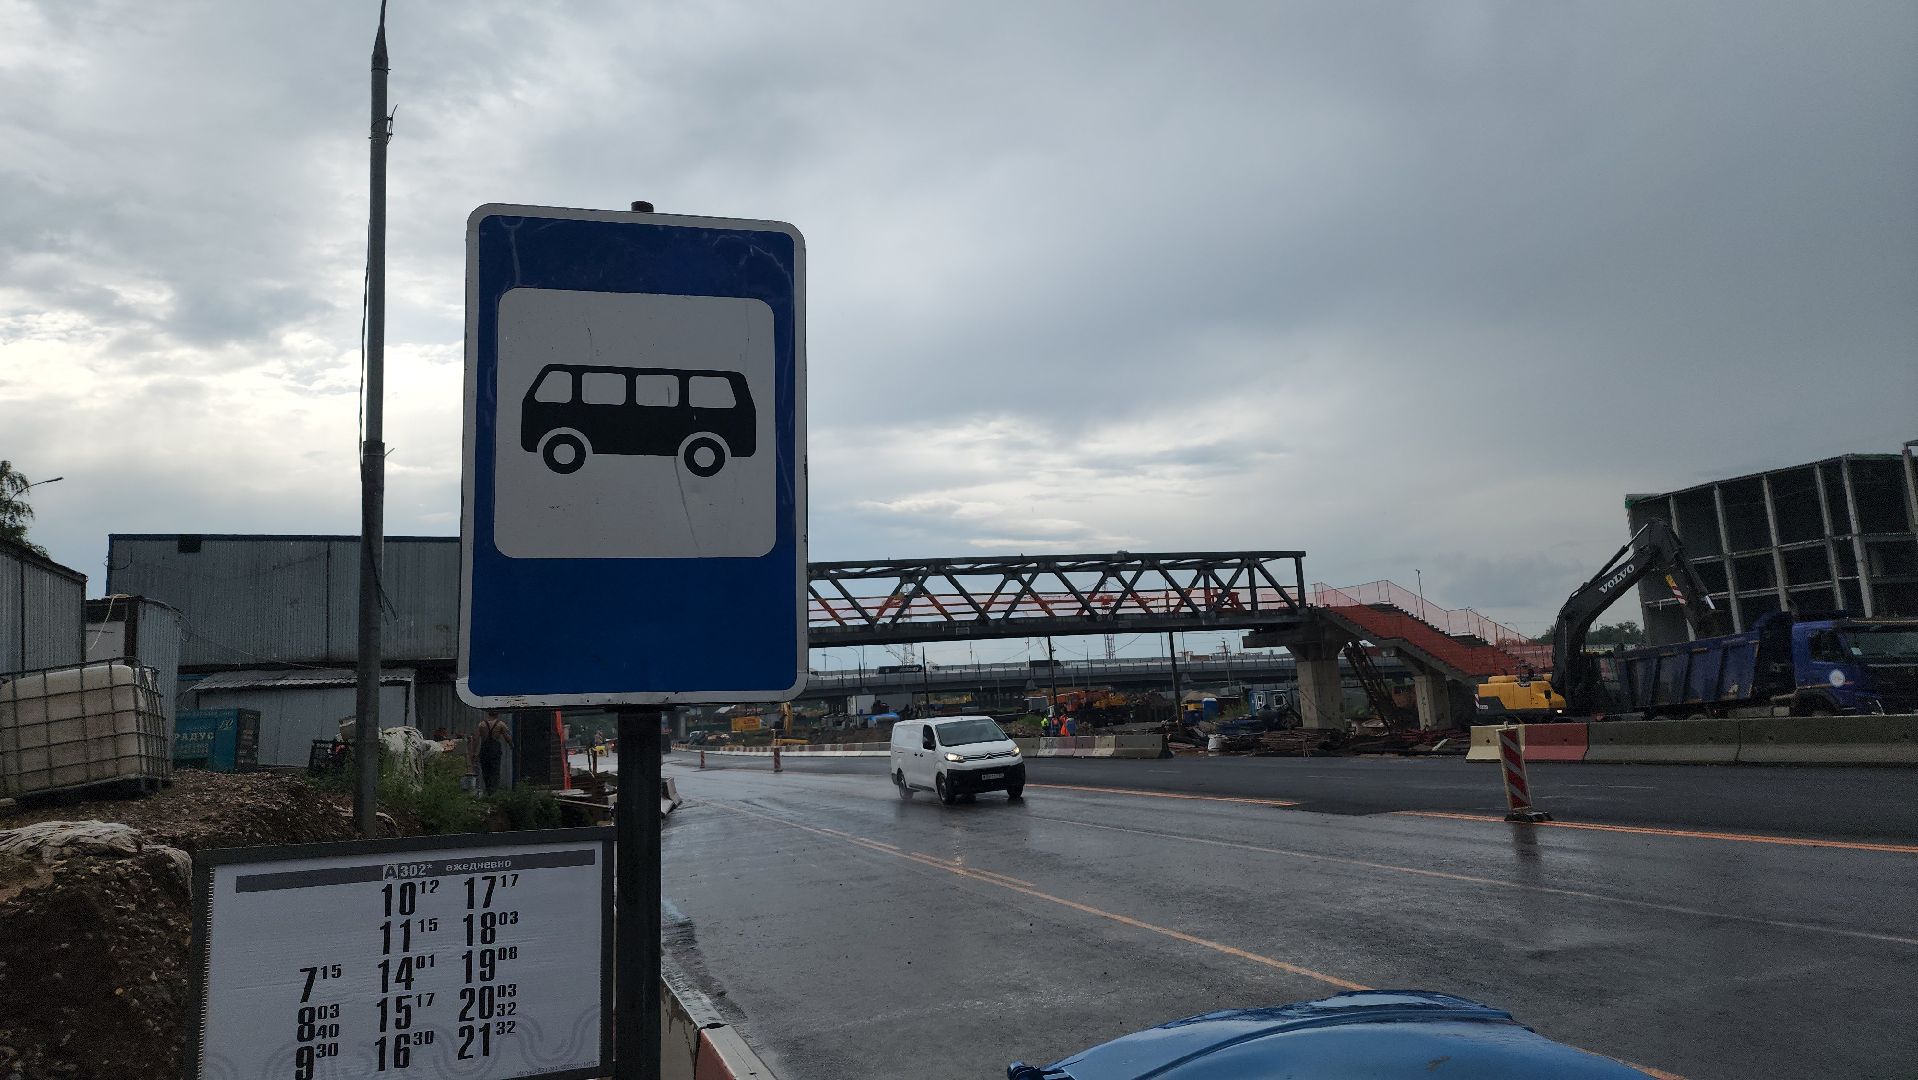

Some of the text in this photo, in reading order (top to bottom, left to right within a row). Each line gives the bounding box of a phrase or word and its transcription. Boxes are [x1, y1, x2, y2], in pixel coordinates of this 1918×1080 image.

[1598, 563, 1635, 593] VOLVO
[445, 860, 512, 873] ежедневно
[381, 882, 416, 917] 10
[464, 876, 496, 909] 17
[380, 919, 412, 955] 11
[463, 912, 497, 946] 18
[378, 957, 415, 993] 14
[462, 949, 496, 984] 19
[300, 967, 318, 1003] 7
[377, 995, 412, 1032] 15
[459, 986, 495, 1022] 20
[297, 1007, 316, 1042] 8
[458, 1023, 491, 1060] 21
[295, 1046, 315, 1080] 9
[375, 1034, 411, 1071] 16
